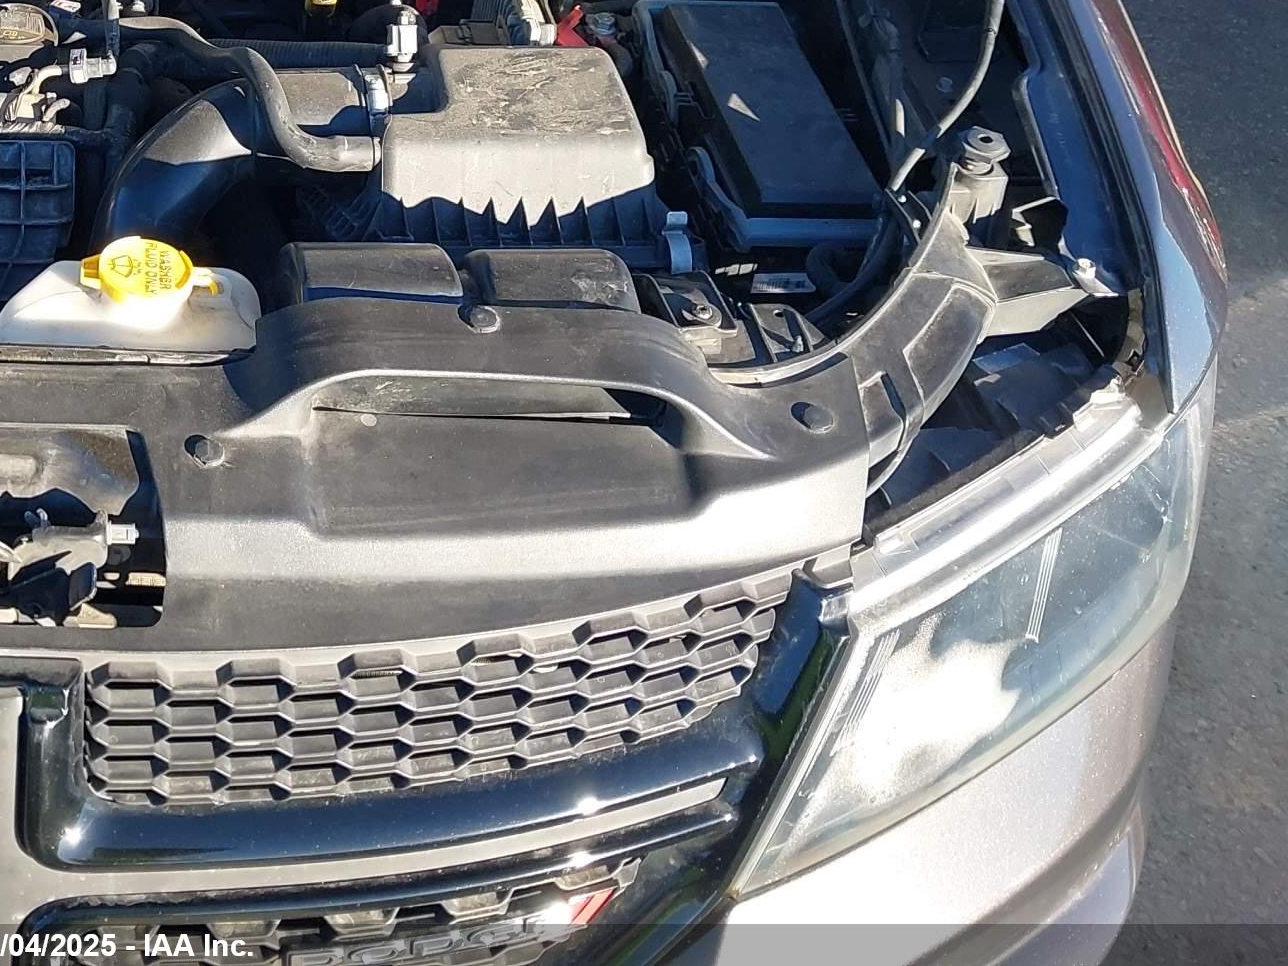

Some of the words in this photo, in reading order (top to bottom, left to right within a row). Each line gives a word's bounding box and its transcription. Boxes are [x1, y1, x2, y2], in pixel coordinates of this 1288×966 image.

[145, 242, 158, 268] FLUID
[144, 270, 158, 295] ONLY
[159, 250, 172, 290] WASHER
